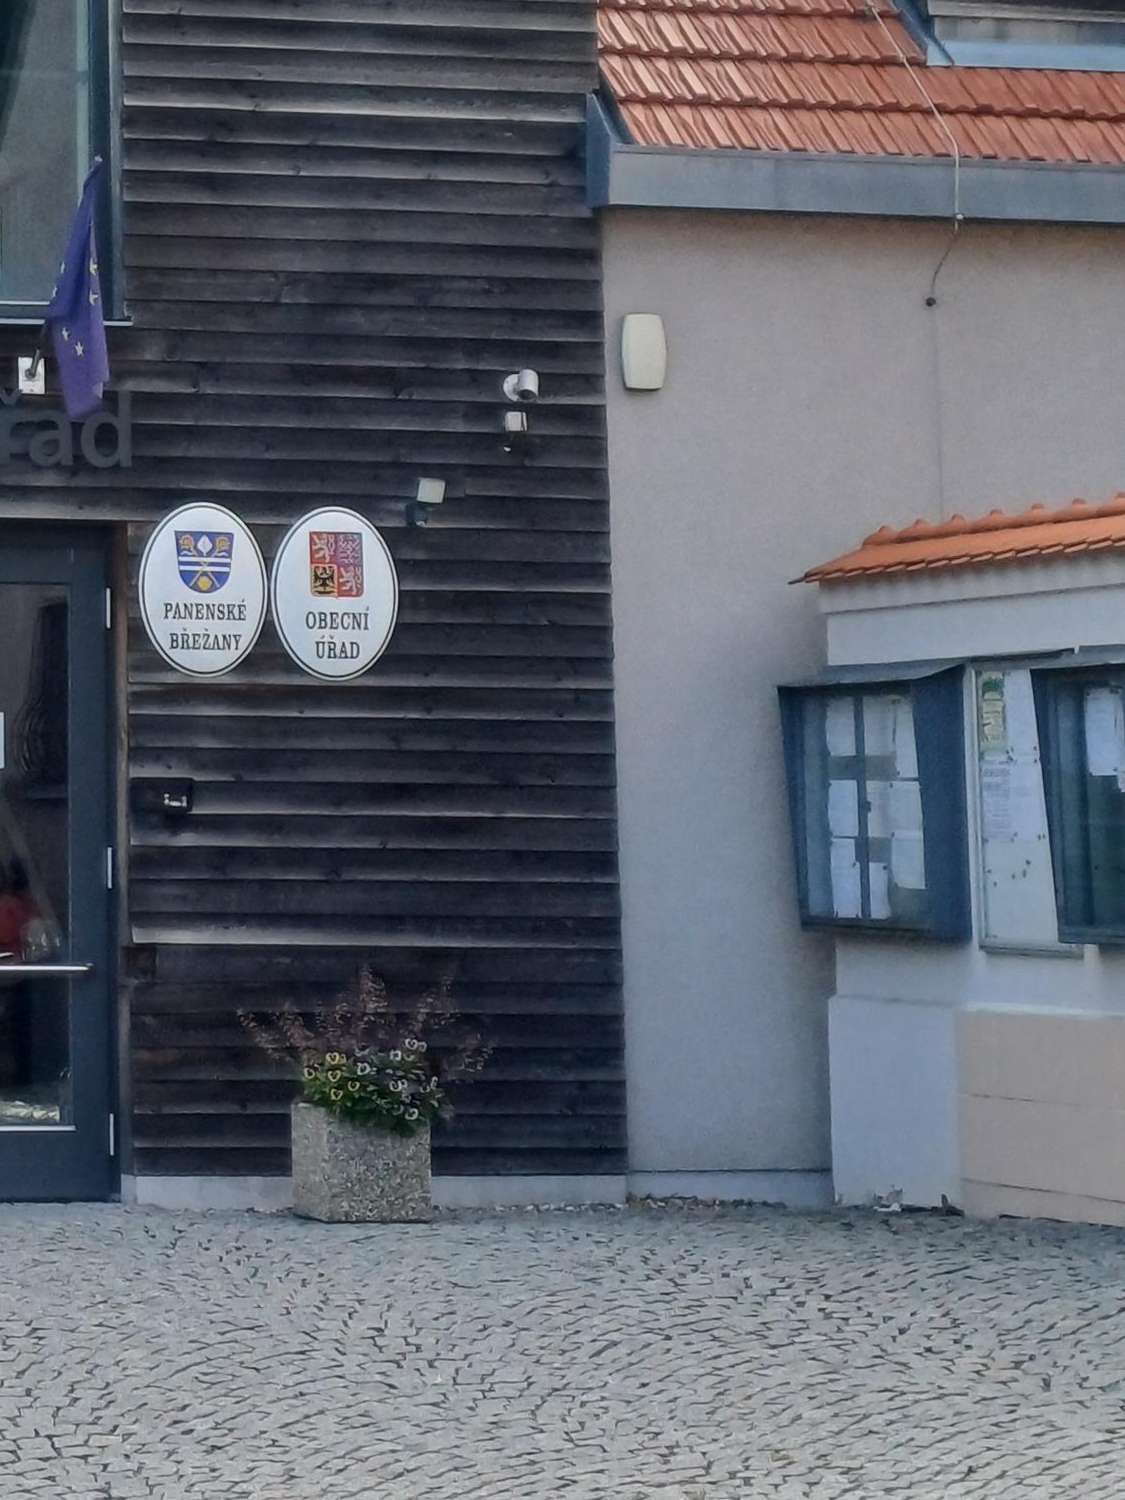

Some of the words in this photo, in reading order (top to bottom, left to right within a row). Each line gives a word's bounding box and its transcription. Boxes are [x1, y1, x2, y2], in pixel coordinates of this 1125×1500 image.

[163, 598, 247, 621] PANENSKÉ
[305, 605, 370, 630] OBECNÍ
[169, 627, 243, 651] BŘEŽANY
[315, 634, 360, 659] ÚŘAD
